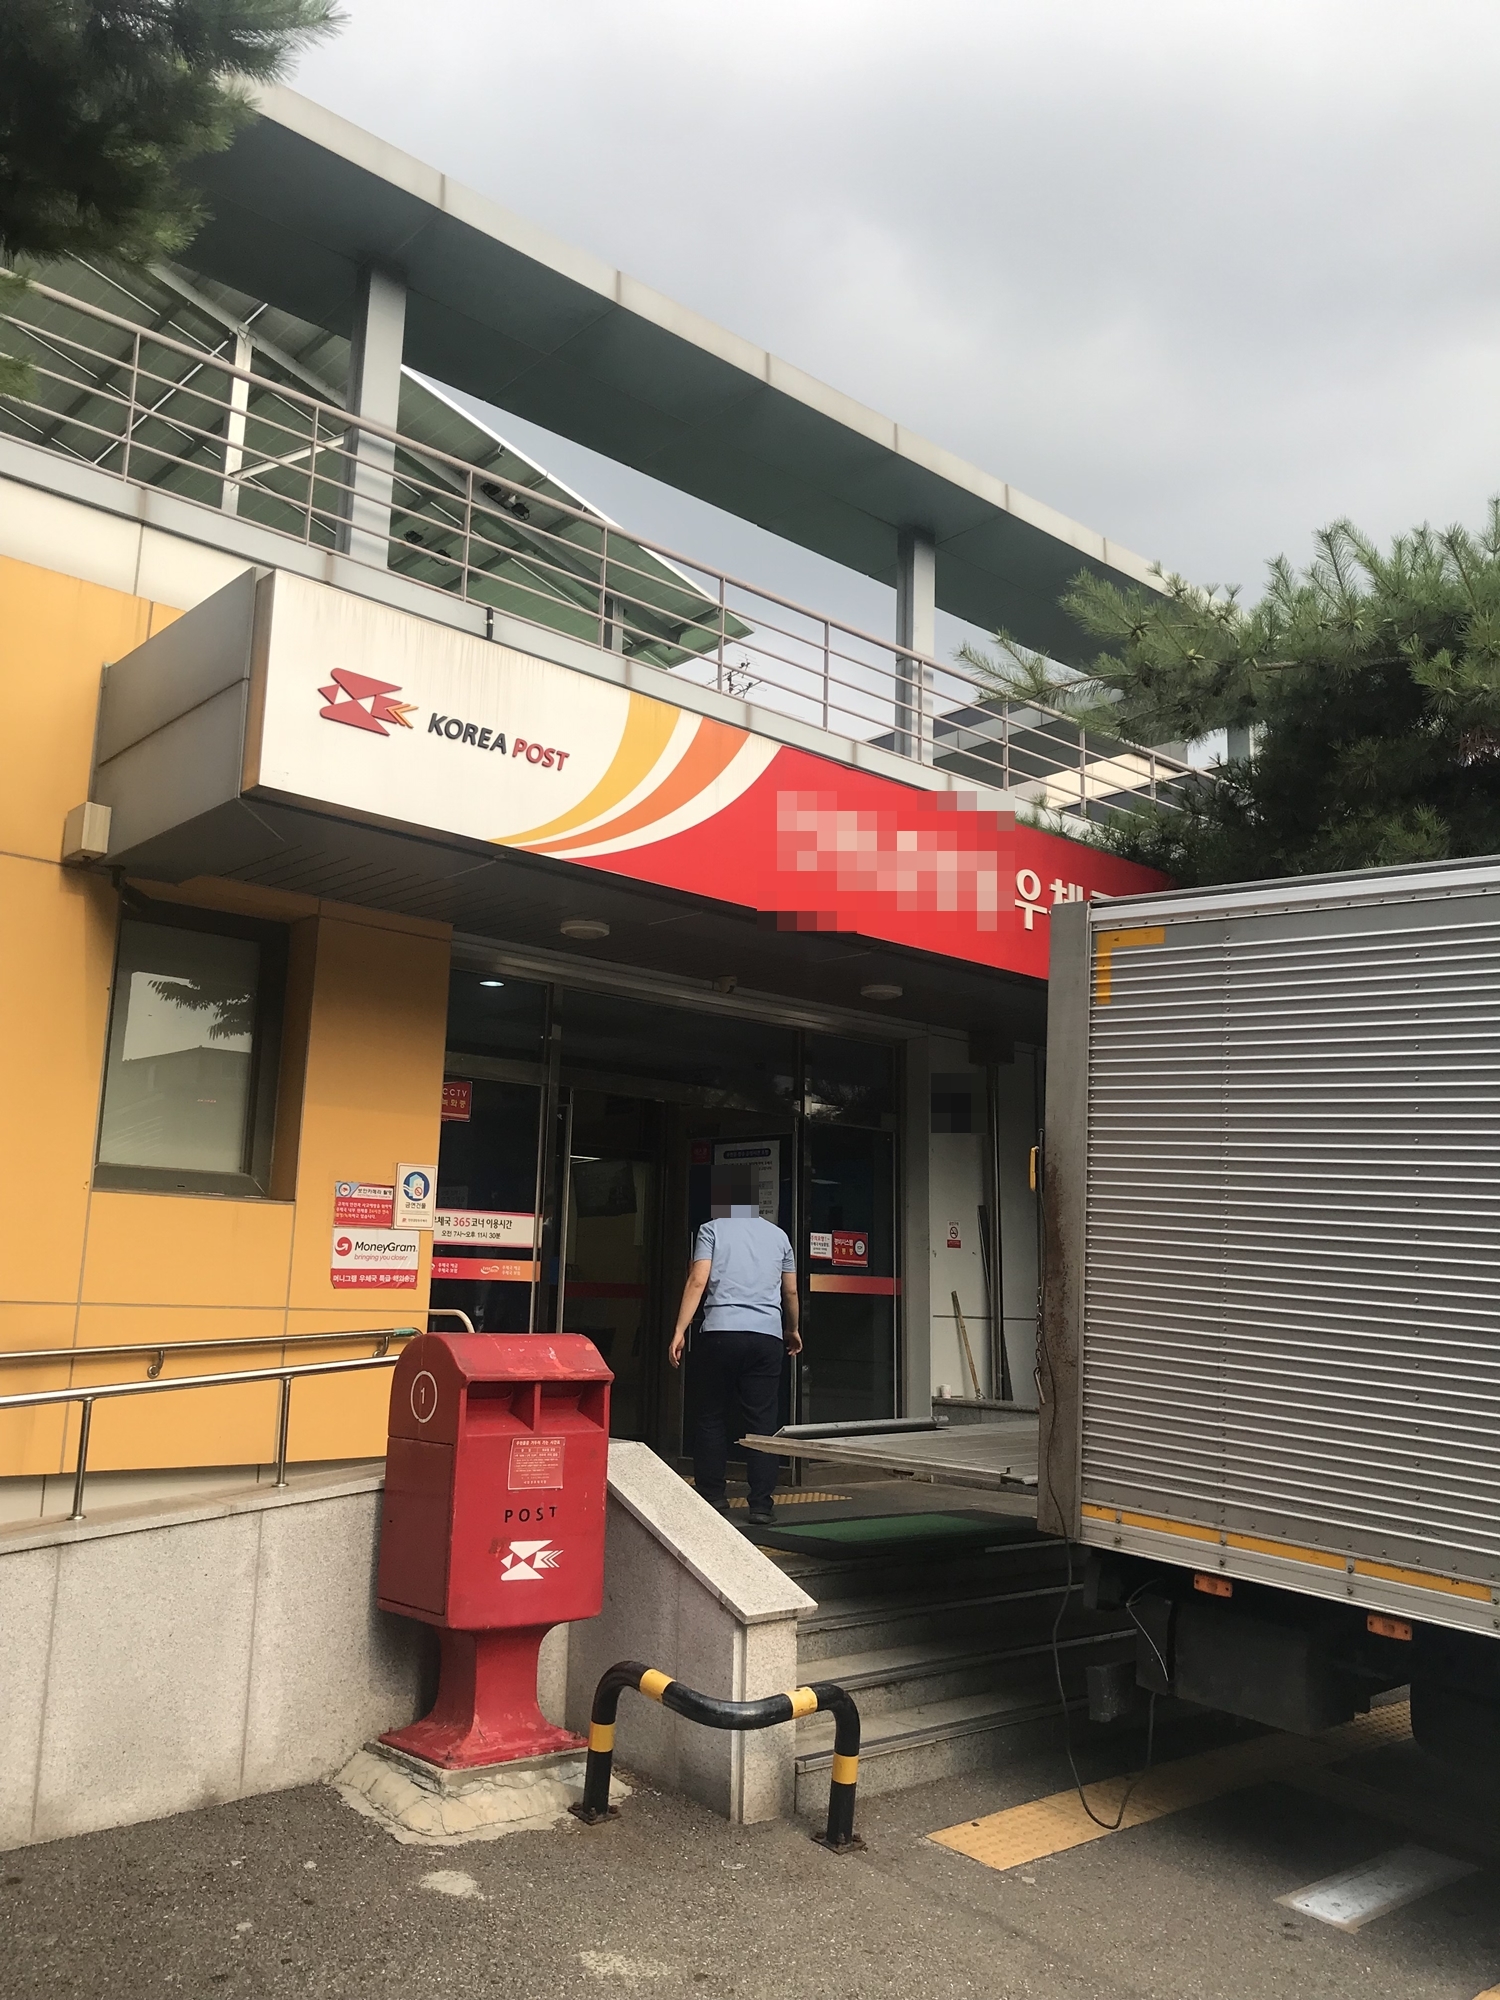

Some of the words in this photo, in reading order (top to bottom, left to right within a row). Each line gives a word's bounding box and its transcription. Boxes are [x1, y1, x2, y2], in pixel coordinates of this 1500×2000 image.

[428, 712, 507, 755] KOREA
[511, 738, 570, 771] POST
[443, 1087, 467, 1097] CCTV
[486, 1218, 513, 1229] 이용시간
[333, 1274, 357, 1282] 머니그램
[359, 1274, 377, 1282] 우체국
[505, 1506, 557, 1523] POST
